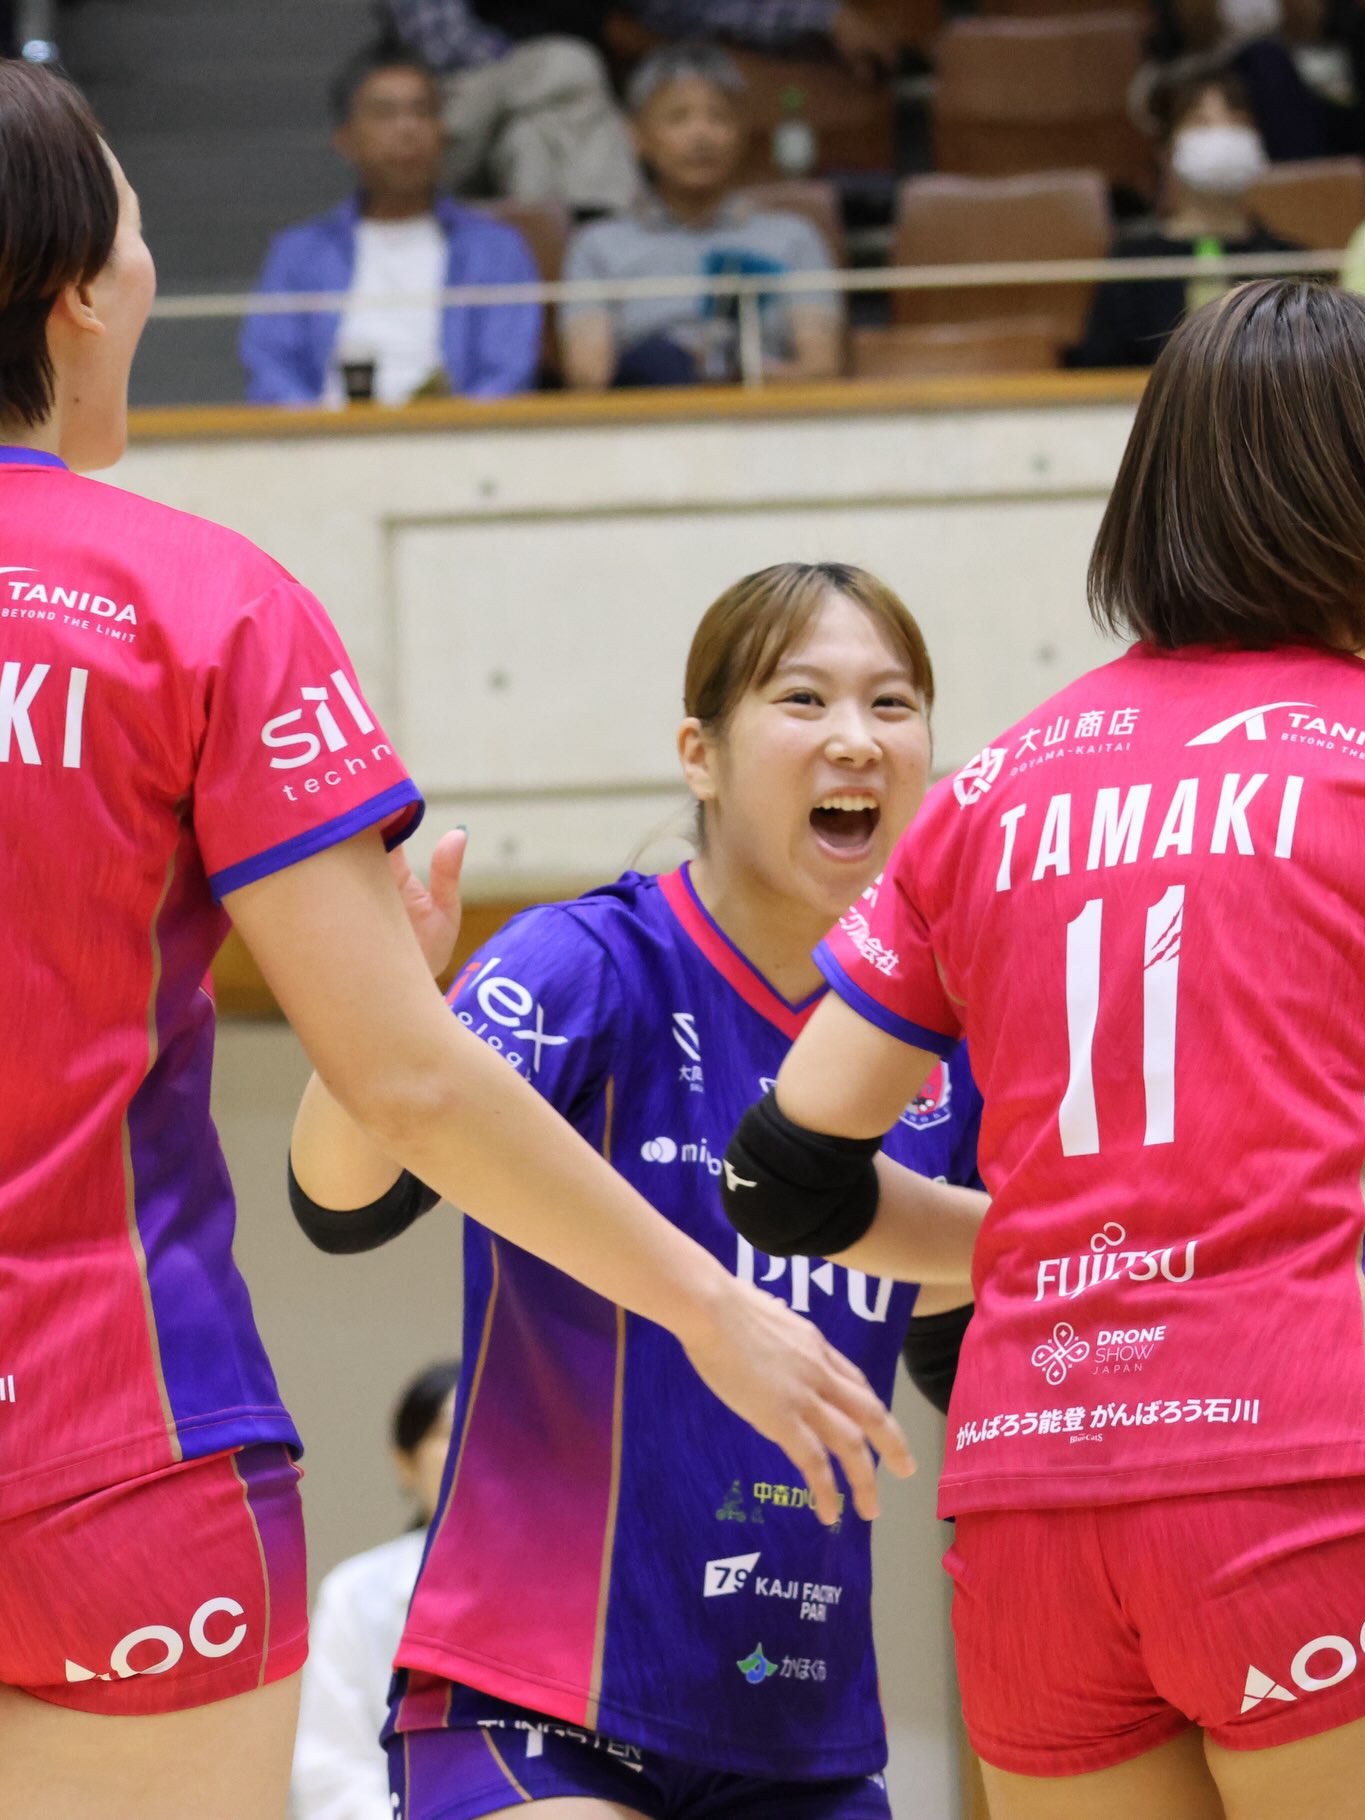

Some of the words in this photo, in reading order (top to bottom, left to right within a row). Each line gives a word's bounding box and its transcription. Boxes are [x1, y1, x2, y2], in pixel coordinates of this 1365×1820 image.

[8, 581, 138, 626] TANIDA
[1, 607, 56, 621] BEYOND
[63, 614, 91, 630] THE
[95, 624, 137, 643] LIMIT
[1014, 707, 1141, 760] 大山商店
[1280, 732, 1335, 750] BEYOND
[996, 772, 1304, 893] TAMAKI
[1058, 884, 1186, 1158] 11
[1035, 1239, 1198, 1302] FUJITSU
[1093, 1342, 1155, 1363] SHOW
[1096, 1325, 1167, 1347] DRONE
[1092, 1362, 1144, 1376] JAPAN
[955, 1406, 1087, 1452] がんばろう能登
[1090, 1398, 1260, 1429] がんばろう石川
[755, 1576, 800, 1601] KAJI
